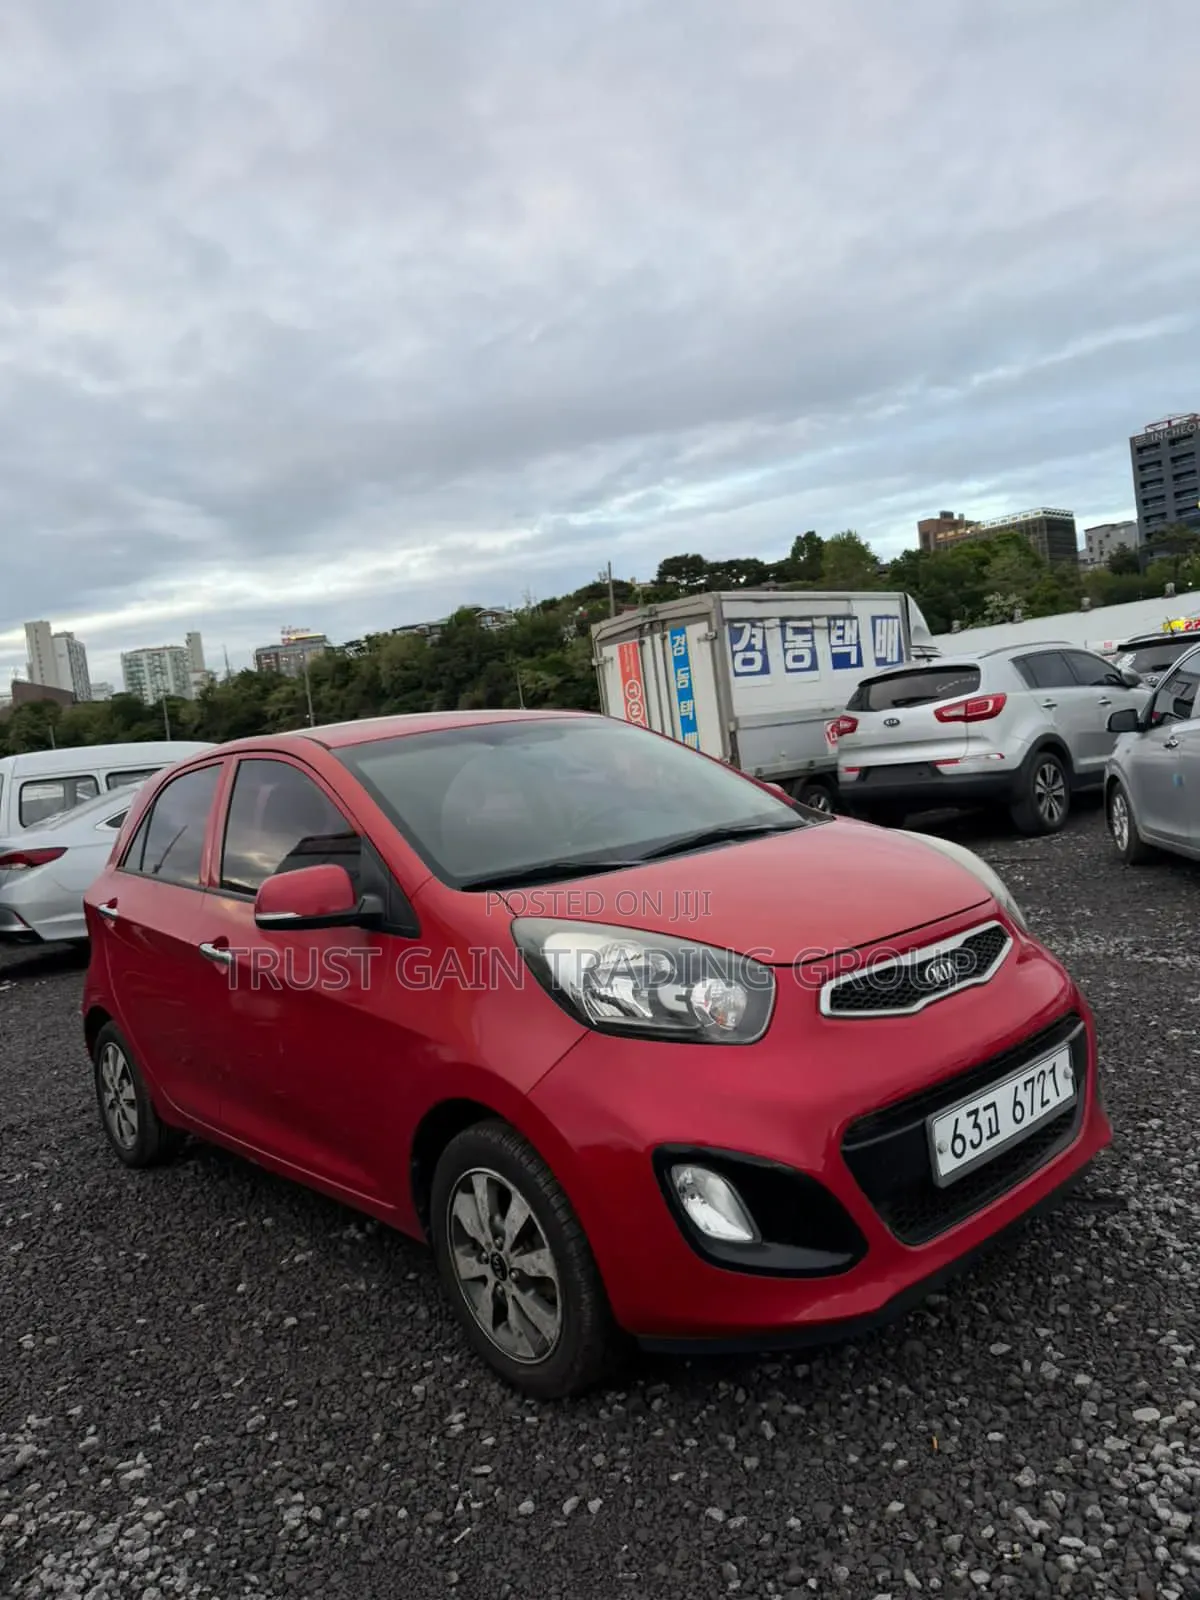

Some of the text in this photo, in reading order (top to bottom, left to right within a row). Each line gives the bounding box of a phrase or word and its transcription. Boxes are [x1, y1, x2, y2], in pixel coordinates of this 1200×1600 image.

[1151, 421, 1200, 441] INCHEO
[733, 619, 899, 673] 경동택배
[951, 1062, 1060, 1159] 63고 6721
